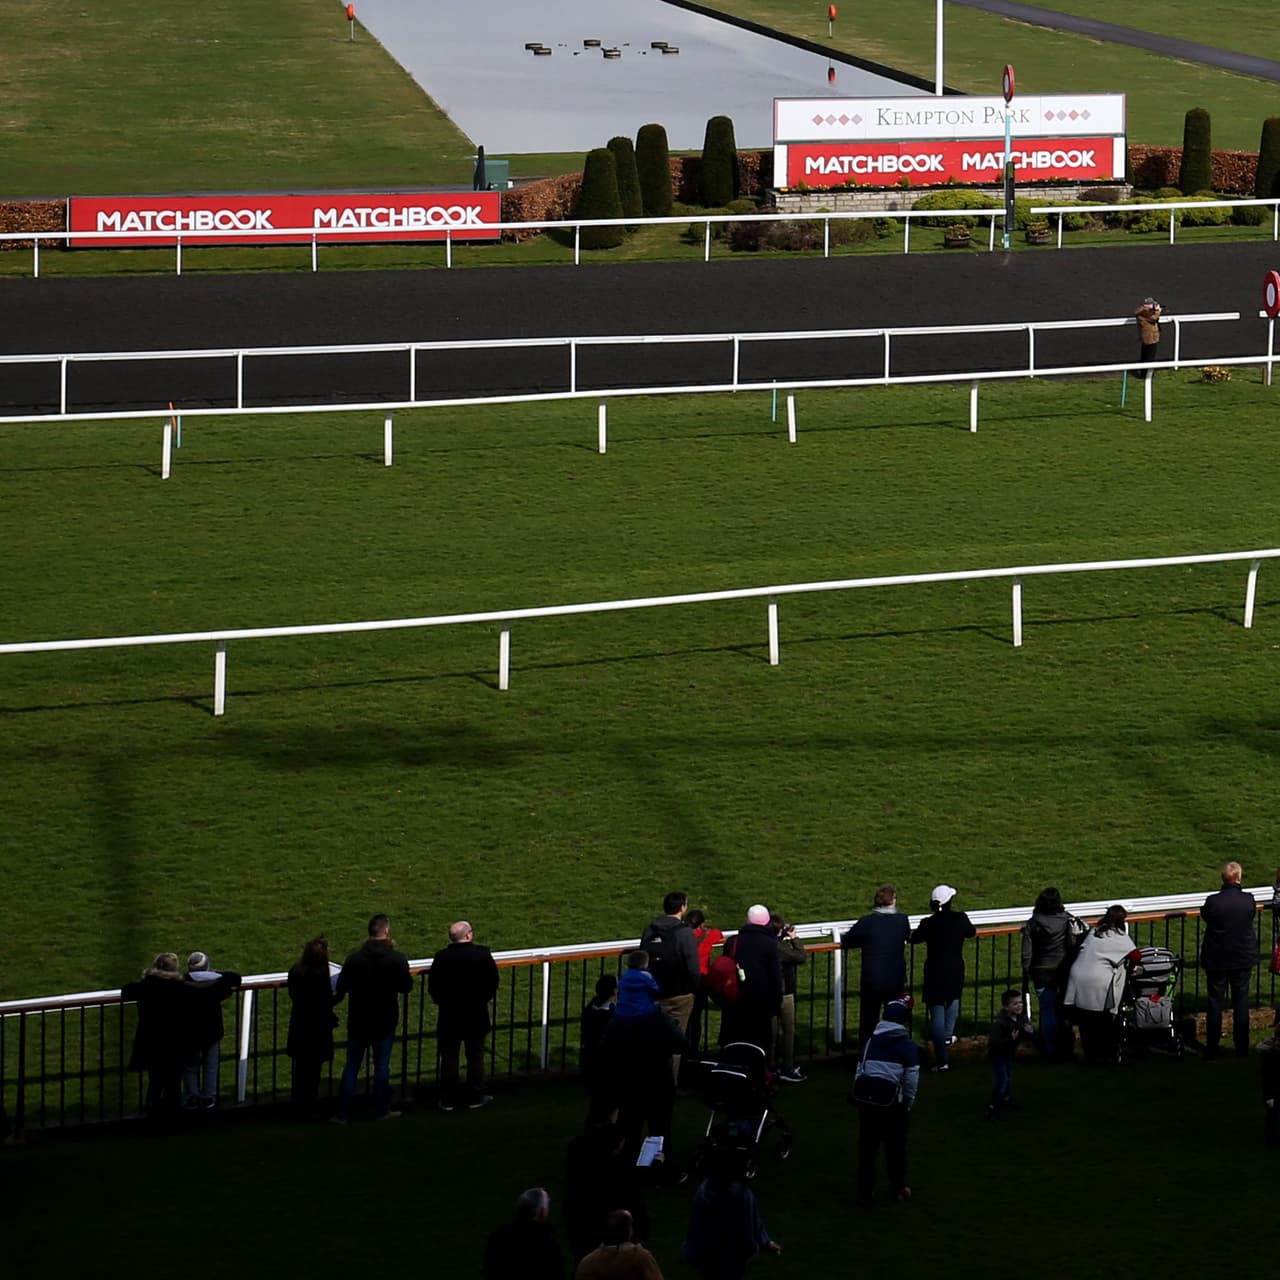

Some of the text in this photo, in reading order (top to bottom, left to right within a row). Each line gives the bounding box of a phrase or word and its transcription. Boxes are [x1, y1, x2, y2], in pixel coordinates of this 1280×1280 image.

[877, 107, 974, 126] KEMPTON
[805, 153, 944, 175] MATCHBOOK
[97, 206, 483, 231] MATCHBOOK MATCHBOOK
